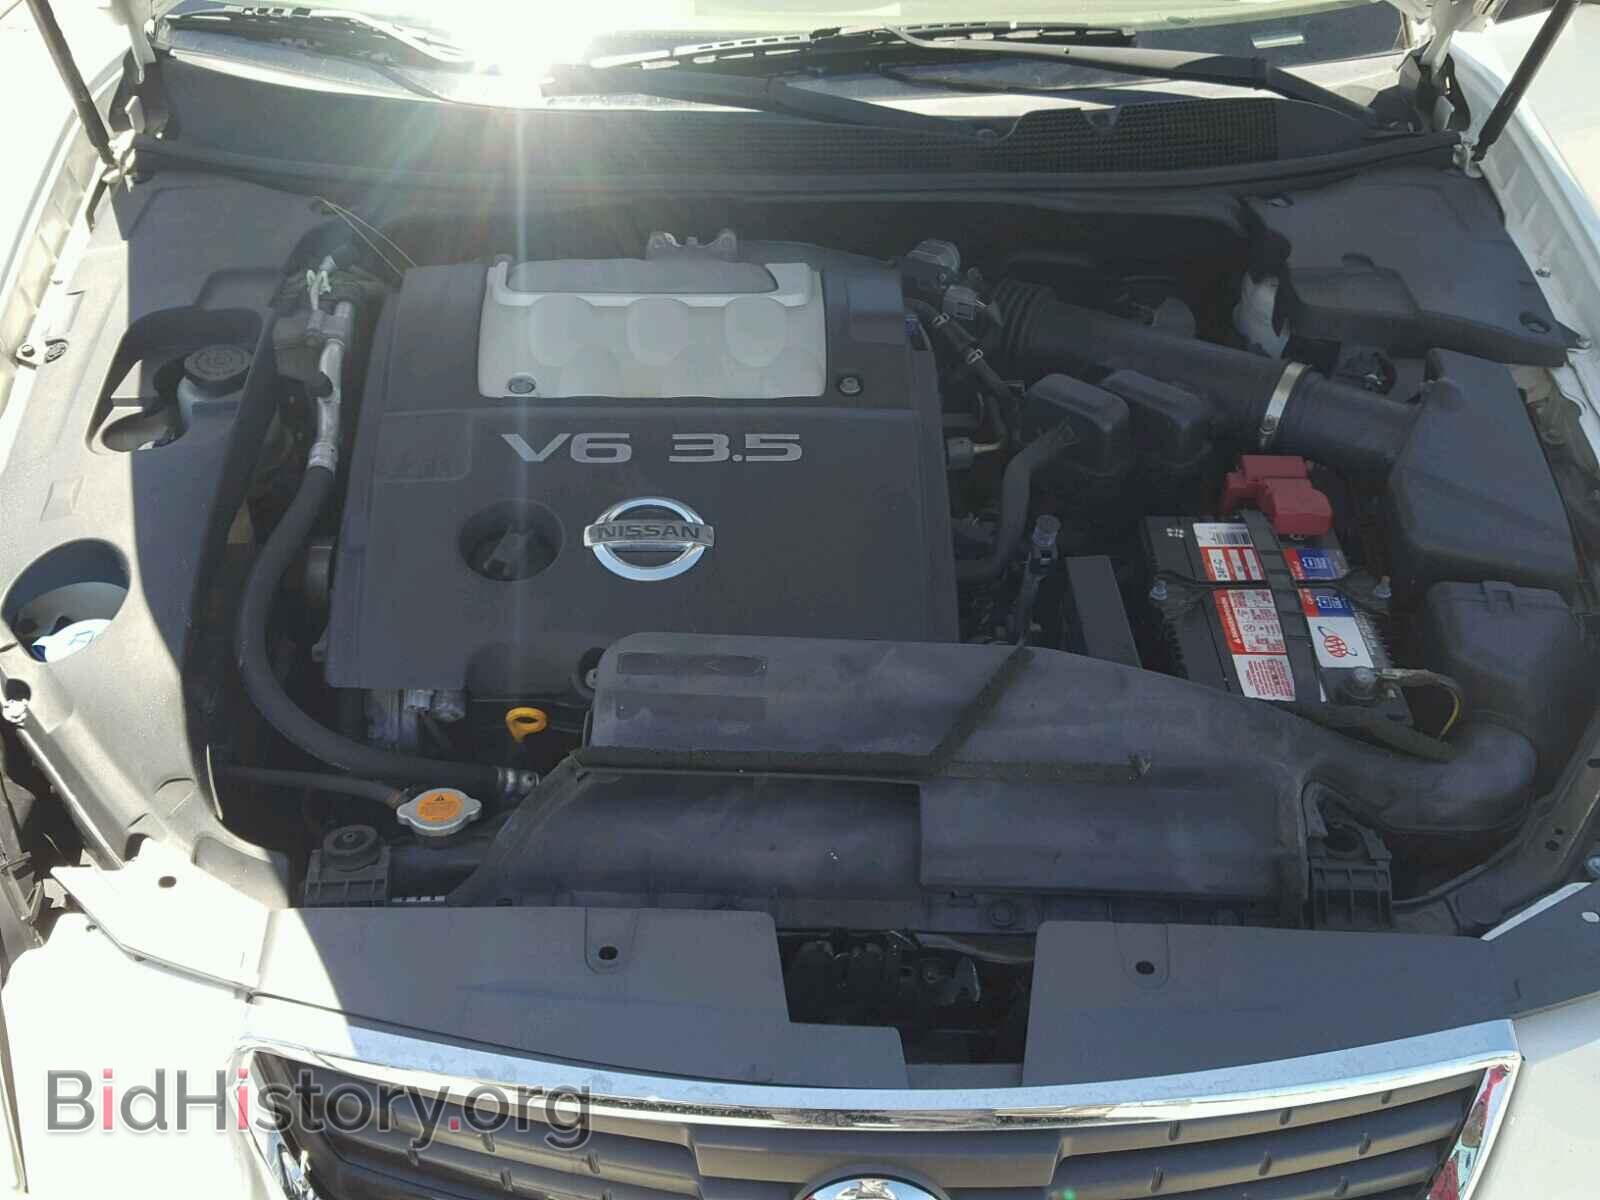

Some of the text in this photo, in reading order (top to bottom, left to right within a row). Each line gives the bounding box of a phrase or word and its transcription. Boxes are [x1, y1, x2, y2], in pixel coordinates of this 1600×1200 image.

[501, 433, 803, 463] V6 3.5
[597, 525, 700, 540] NISSAN
